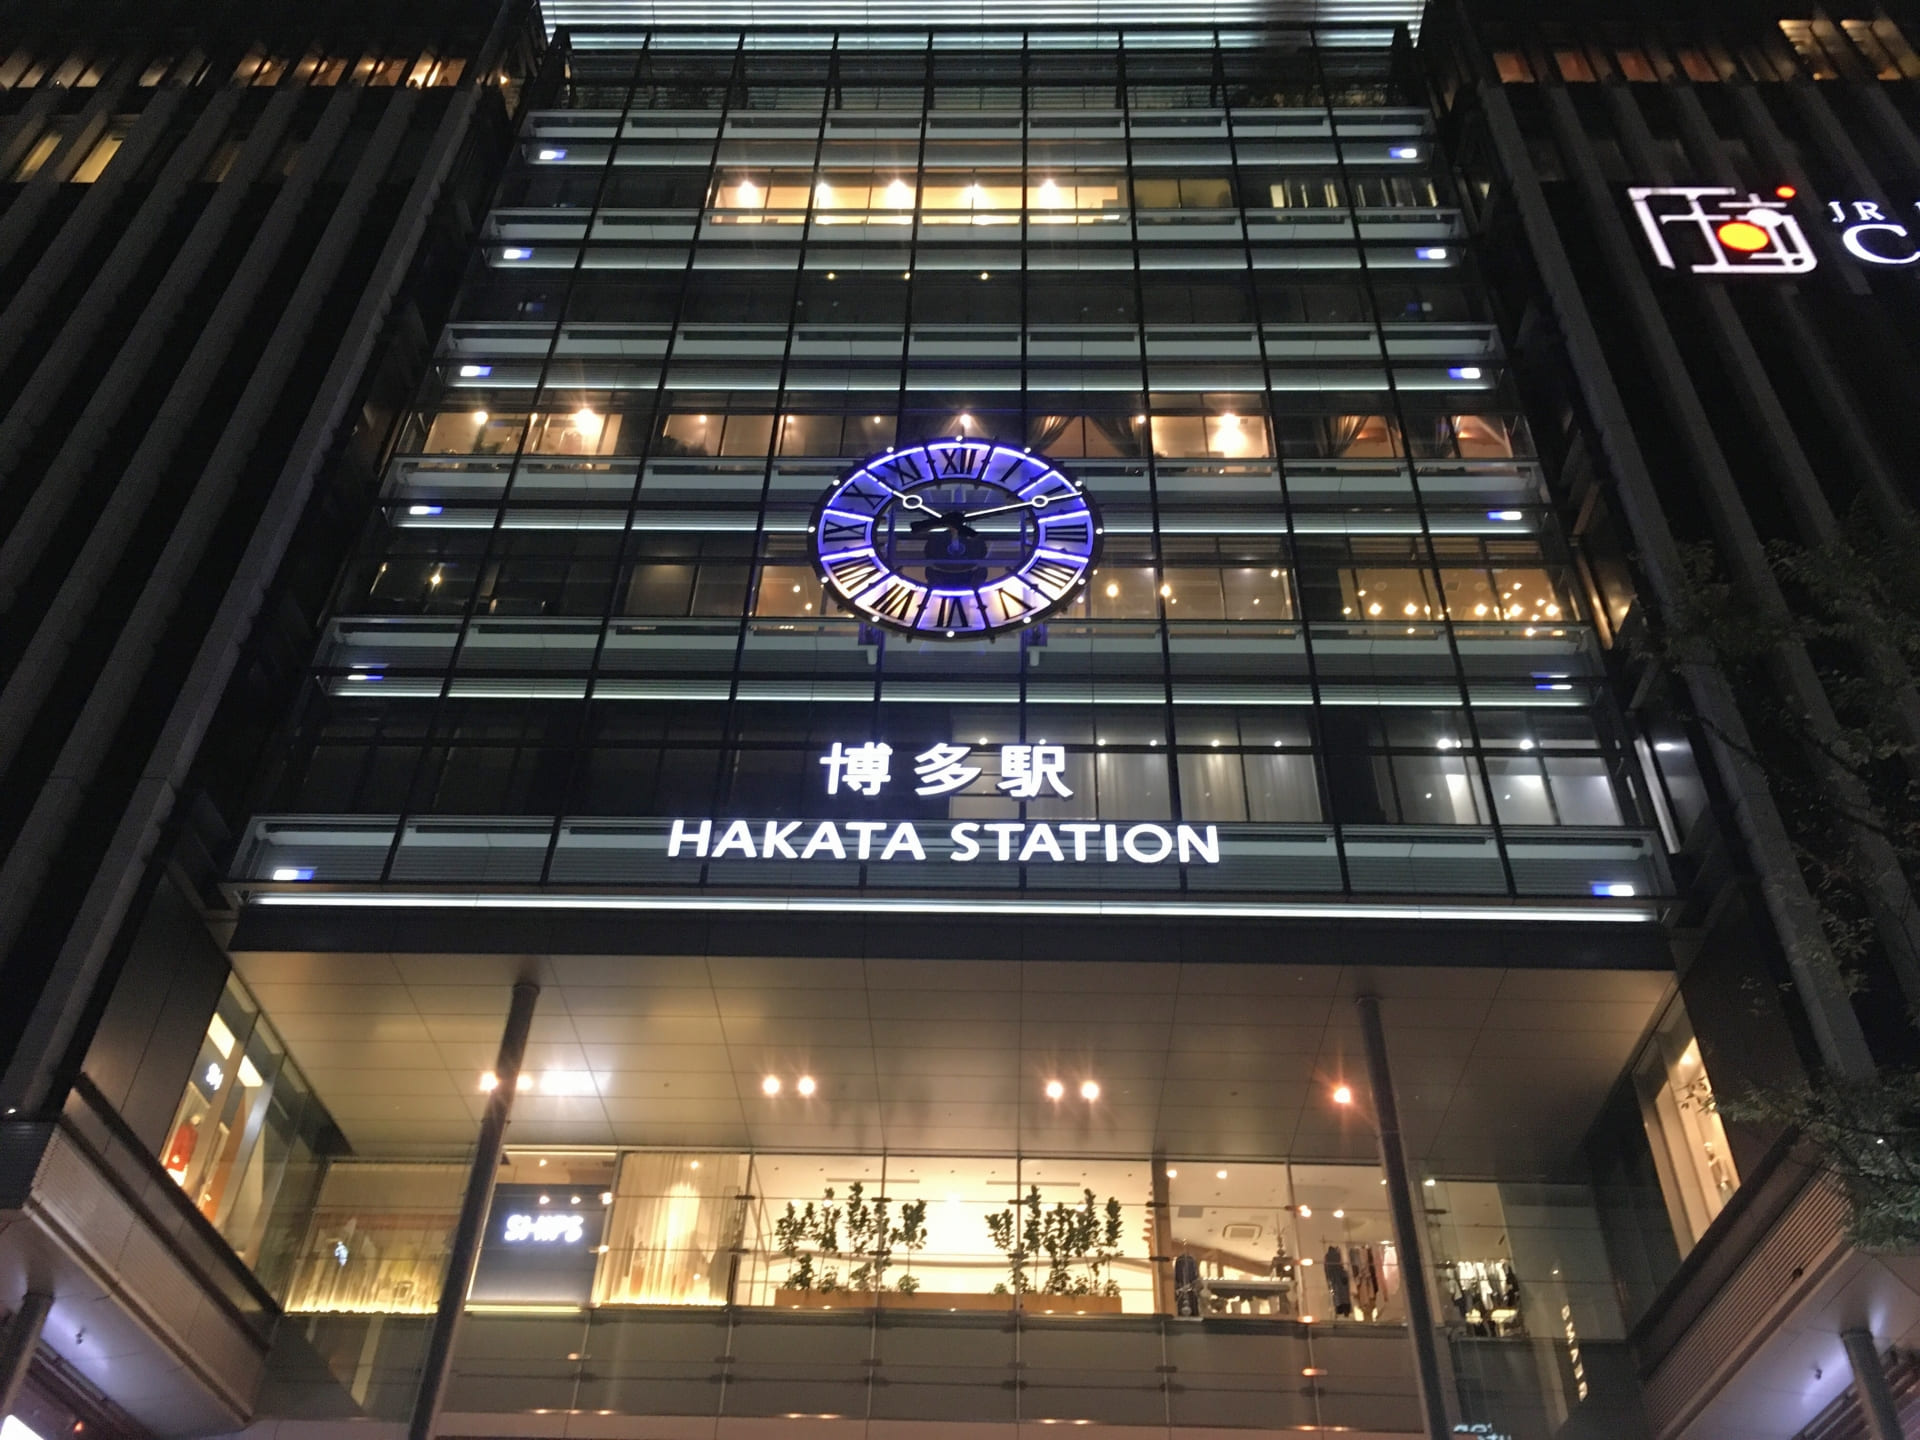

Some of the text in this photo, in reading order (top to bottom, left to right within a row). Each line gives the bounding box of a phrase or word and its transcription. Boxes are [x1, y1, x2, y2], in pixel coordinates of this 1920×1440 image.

[1828, 201, 1886, 223] JR
[883, 453, 925, 486] XI
[940, 448, 979, 475] XII
[839, 481, 889, 510] X
[822, 519, 867, 544] IX
[1043, 523, 1088, 544] III
[868, 583, 918, 622] VII
[935, 596, 972, 628] VI
[995, 587, 1037, 621] V
[817, 738, 1075, 798] 博多駅
[667, 818, 1221, 864] HAKATA STATION
